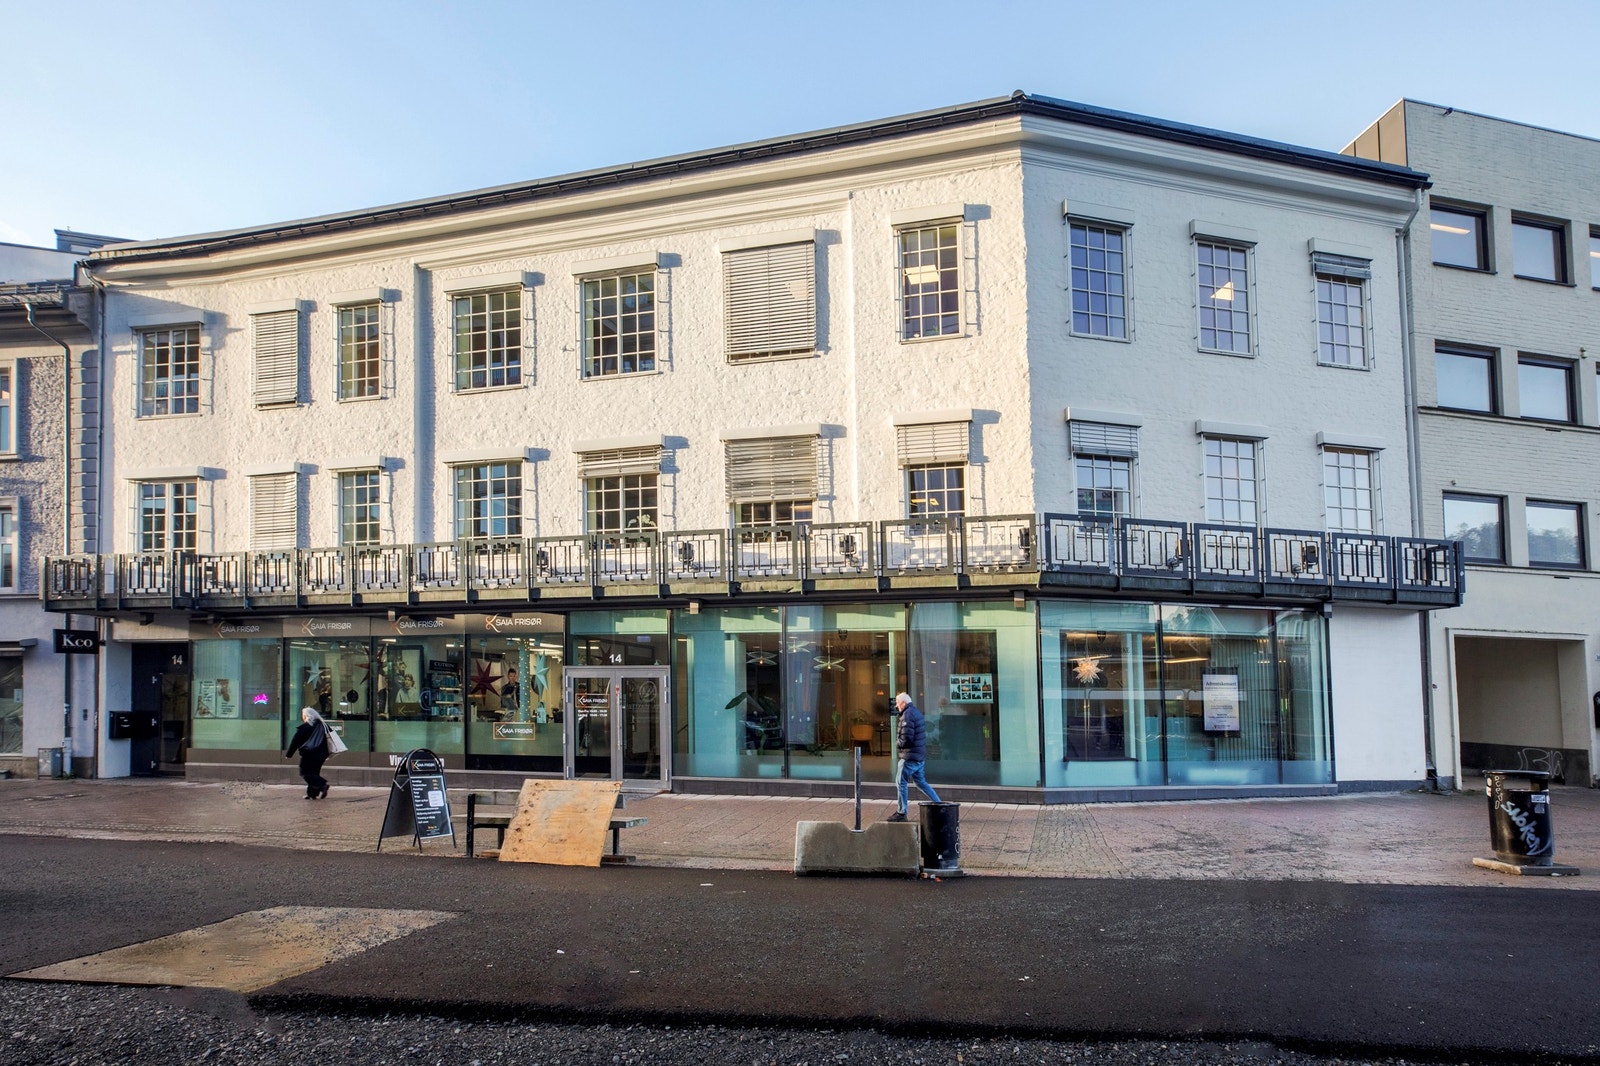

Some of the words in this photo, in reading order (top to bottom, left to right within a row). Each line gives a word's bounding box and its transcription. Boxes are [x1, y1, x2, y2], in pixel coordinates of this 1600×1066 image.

[327, 622, 352, 630] FRISØR
[400, 621, 417, 629] SAIA
[418, 620, 444, 628] FRISØR
[514, 618, 542, 626] FRISØR
[62, 634, 93, 647] Kco
[171, 654, 183, 665] 14
[609, 654, 622, 663] 14
